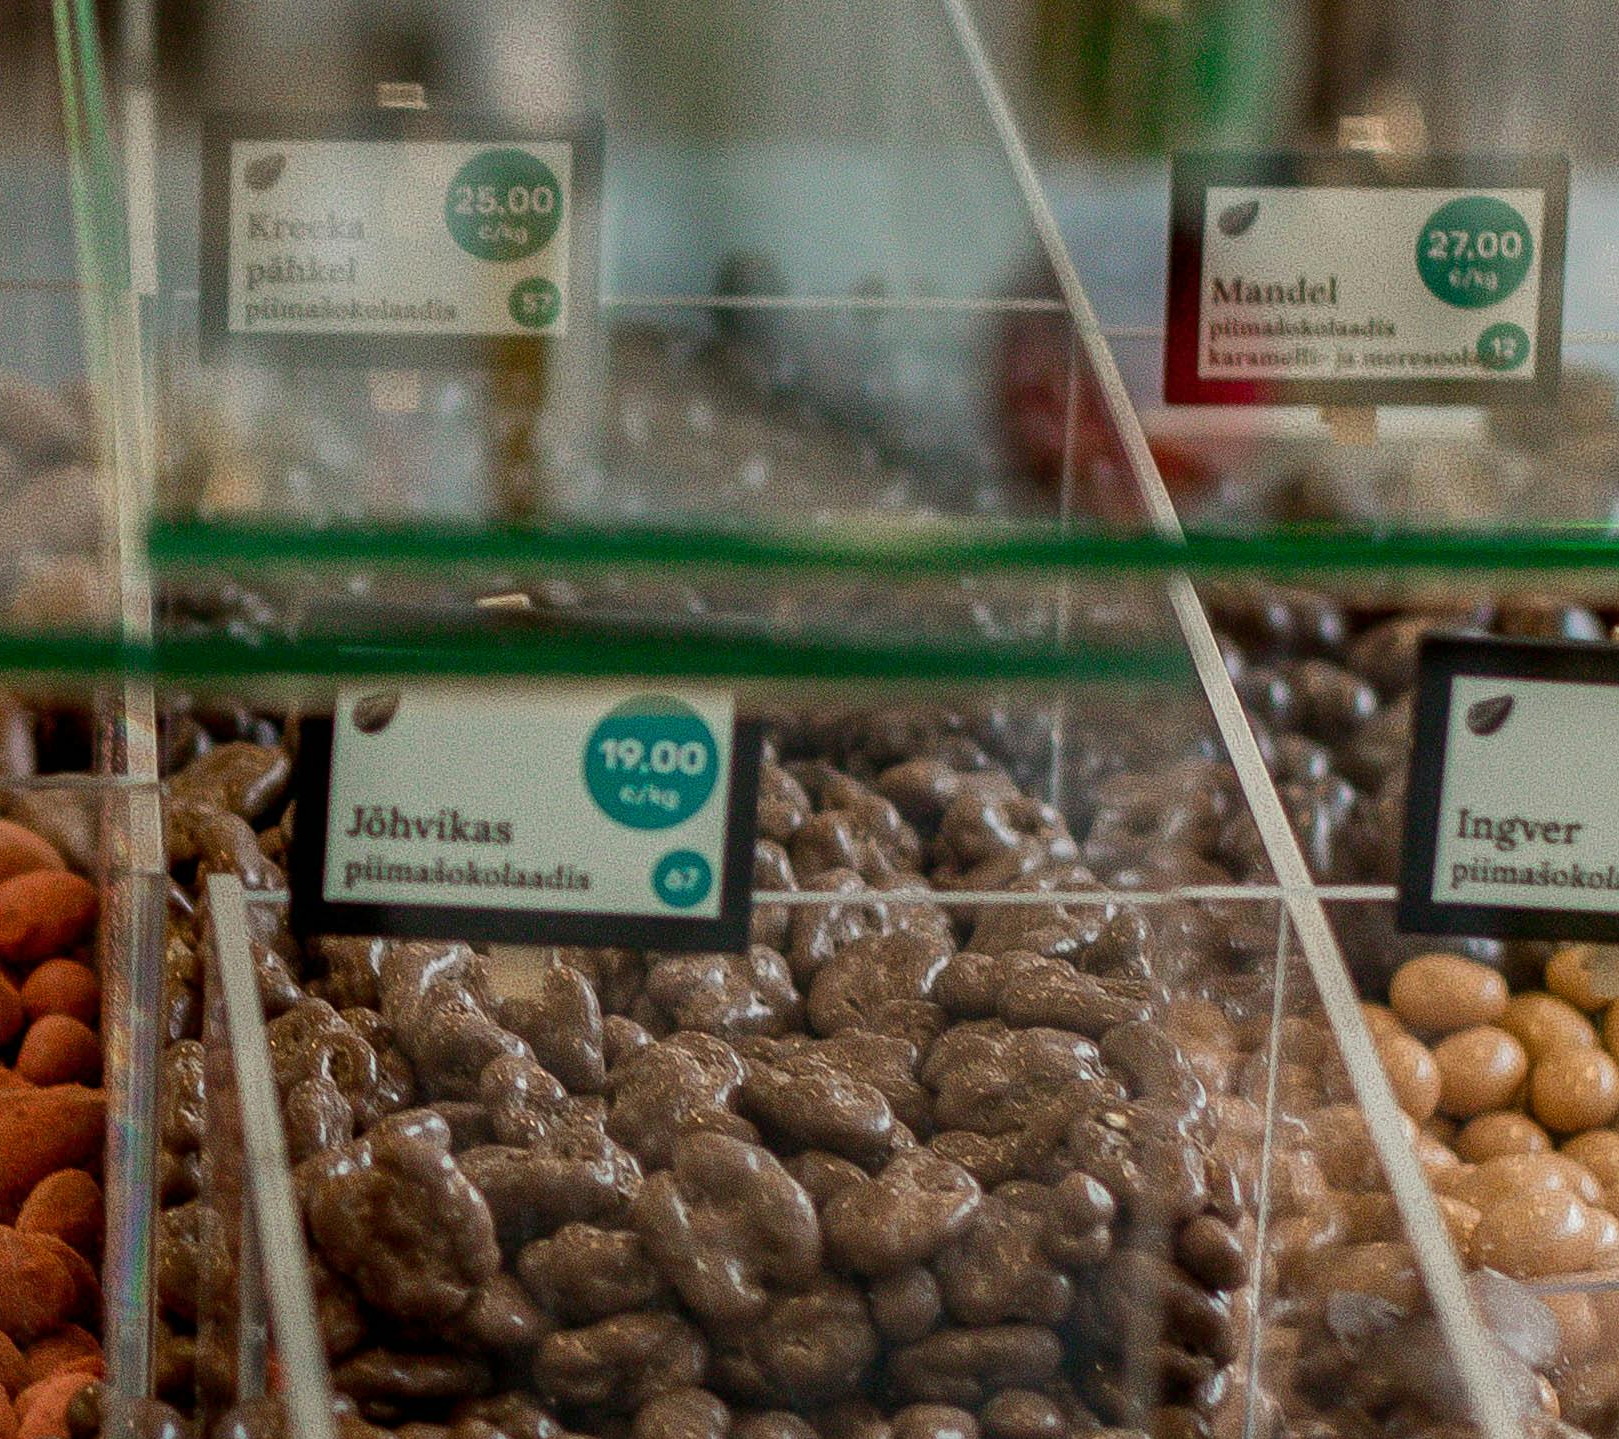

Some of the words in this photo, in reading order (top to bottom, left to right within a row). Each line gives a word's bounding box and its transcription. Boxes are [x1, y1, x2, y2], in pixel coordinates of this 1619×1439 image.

[456, 186, 555, 215] 25.00
[1427, 230, 1522, 260] 27.00
[247, 257, 357, 291] pähkel
[1211, 273, 1339, 306] Mandel
[597, 737, 709, 776] 19.00
[346, 804, 515, 846] Jõhvikas
[1457, 807, 1584, 853] Ingver
[344, 855, 592, 892] piimašokolaadis
